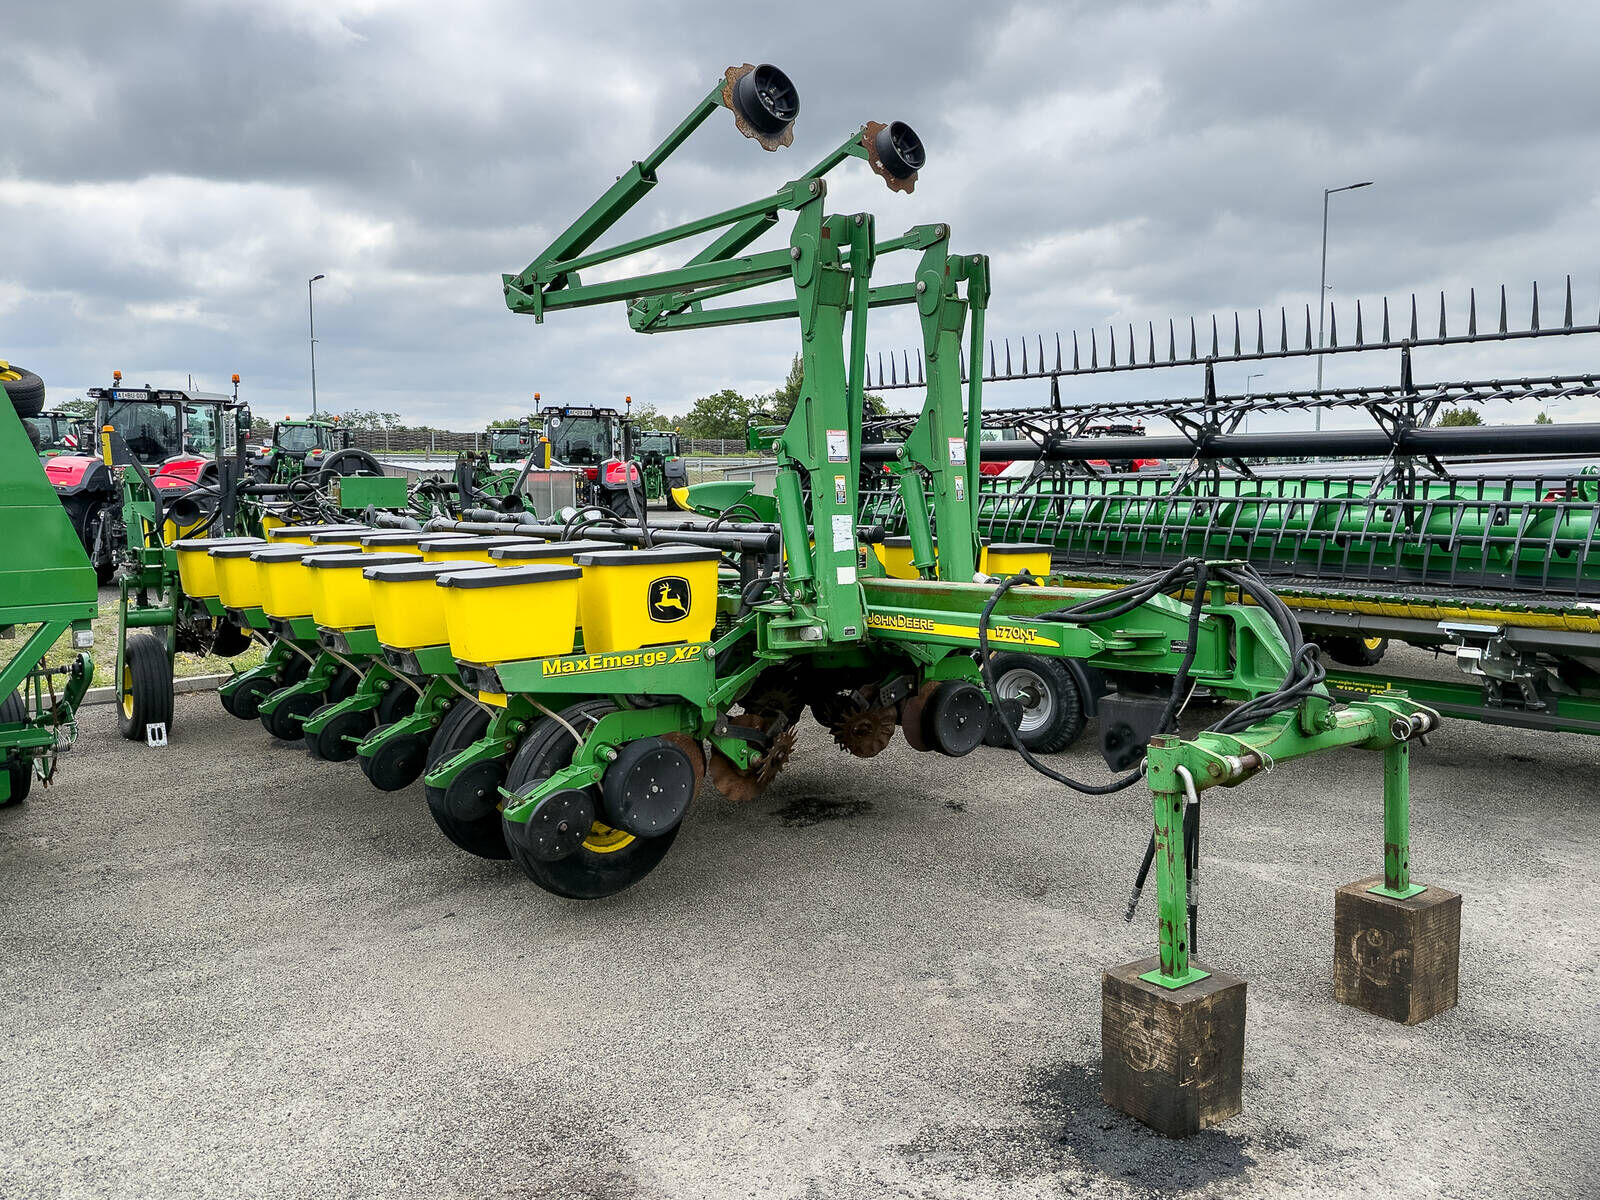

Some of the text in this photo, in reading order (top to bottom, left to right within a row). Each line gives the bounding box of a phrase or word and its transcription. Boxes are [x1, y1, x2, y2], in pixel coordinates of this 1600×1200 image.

[867, 612, 935, 630] JOHN DEERE
[994, 625, 1038, 642] 1770NT
[542, 645, 702, 676] MaxEmerge XP
